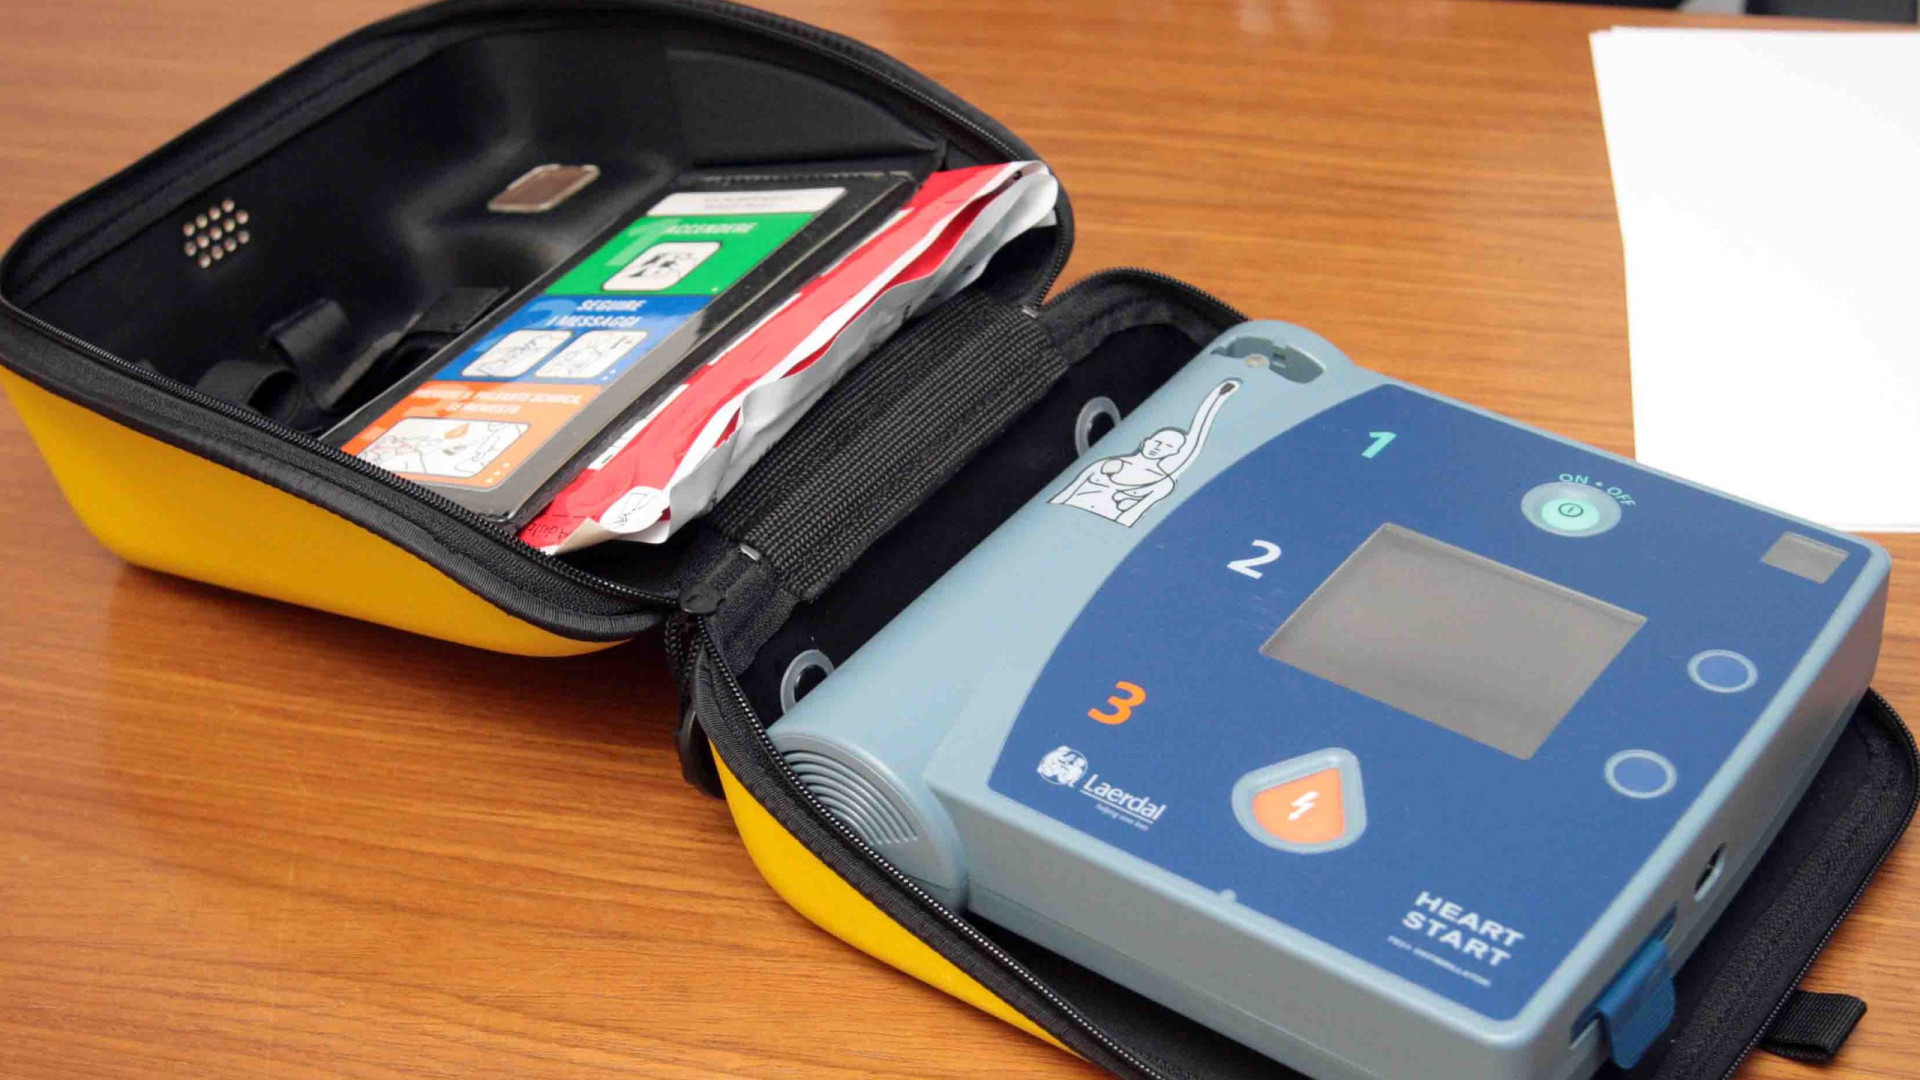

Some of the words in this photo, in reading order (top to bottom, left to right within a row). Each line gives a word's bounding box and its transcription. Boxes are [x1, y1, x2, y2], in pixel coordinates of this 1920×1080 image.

[559, 315, 643, 328] MESSAGGI
[576, 300, 647, 311] SEGUIRE
[1361, 431, 1397, 459] 1
[1559, 473, 1589, 485] ON
[1607, 486, 1636, 506] OFF
[1226, 539, 1282, 580] 2
[1087, 680, 1147, 725] 3
[1083, 774, 1168, 821] Laerdal
[1402, 910, 1512, 967] START
[1415, 891, 1525, 948] HEART
